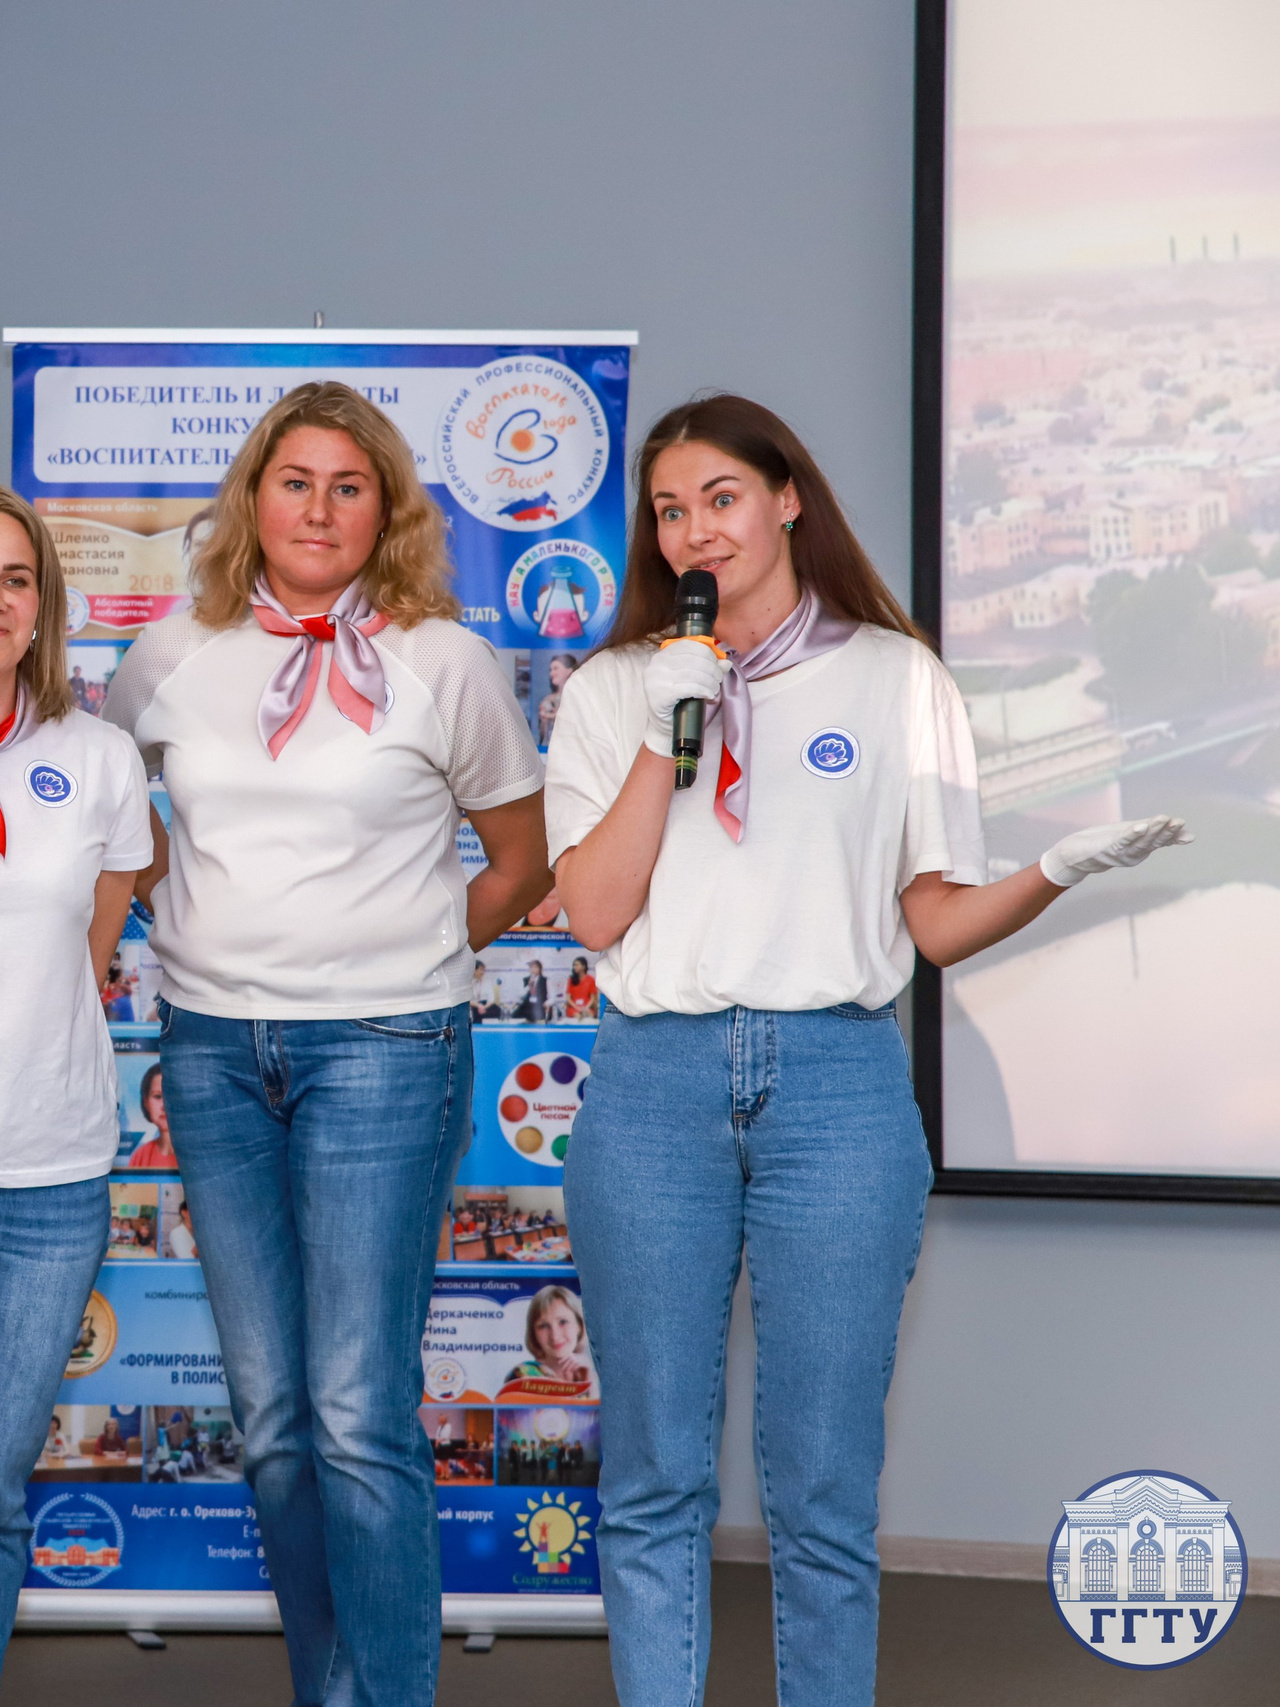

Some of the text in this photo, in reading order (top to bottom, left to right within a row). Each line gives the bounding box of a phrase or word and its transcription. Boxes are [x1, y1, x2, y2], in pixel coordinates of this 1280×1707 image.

[75, 386, 238, 406] ПОБЕДИТЕЛЬ
[246, 387, 261, 404] И
[441, 362, 603, 504] ВСЕРОССИЙСКИЙ ПРОФЕССИОНАЛЬНЫЙ КОНКУРС
[47, 448, 236, 465] «ВОСПИТАТЕЛЬ
[485, 467, 554, 489] России
[47, 502, 158, 513] Московская область
[60, 550, 125, 560] настасия
[62, 566, 119, 576] вановна
[129, 574, 174, 592] 2018
[94, 597, 153, 608] Абсолютный
[94, 608, 149, 620] победитель
[432, 1280, 520, 1291] сковская область
[423, 1340, 523, 1354] Владимировна
[171, 1371, 179, 1384] В
[521, 1382, 577, 1394] Лауреат
[131, 1504, 167, 1518] Адрес:
[455, 1510, 494, 1523] корпус
[208, 1545, 253, 1560] Телефон:
